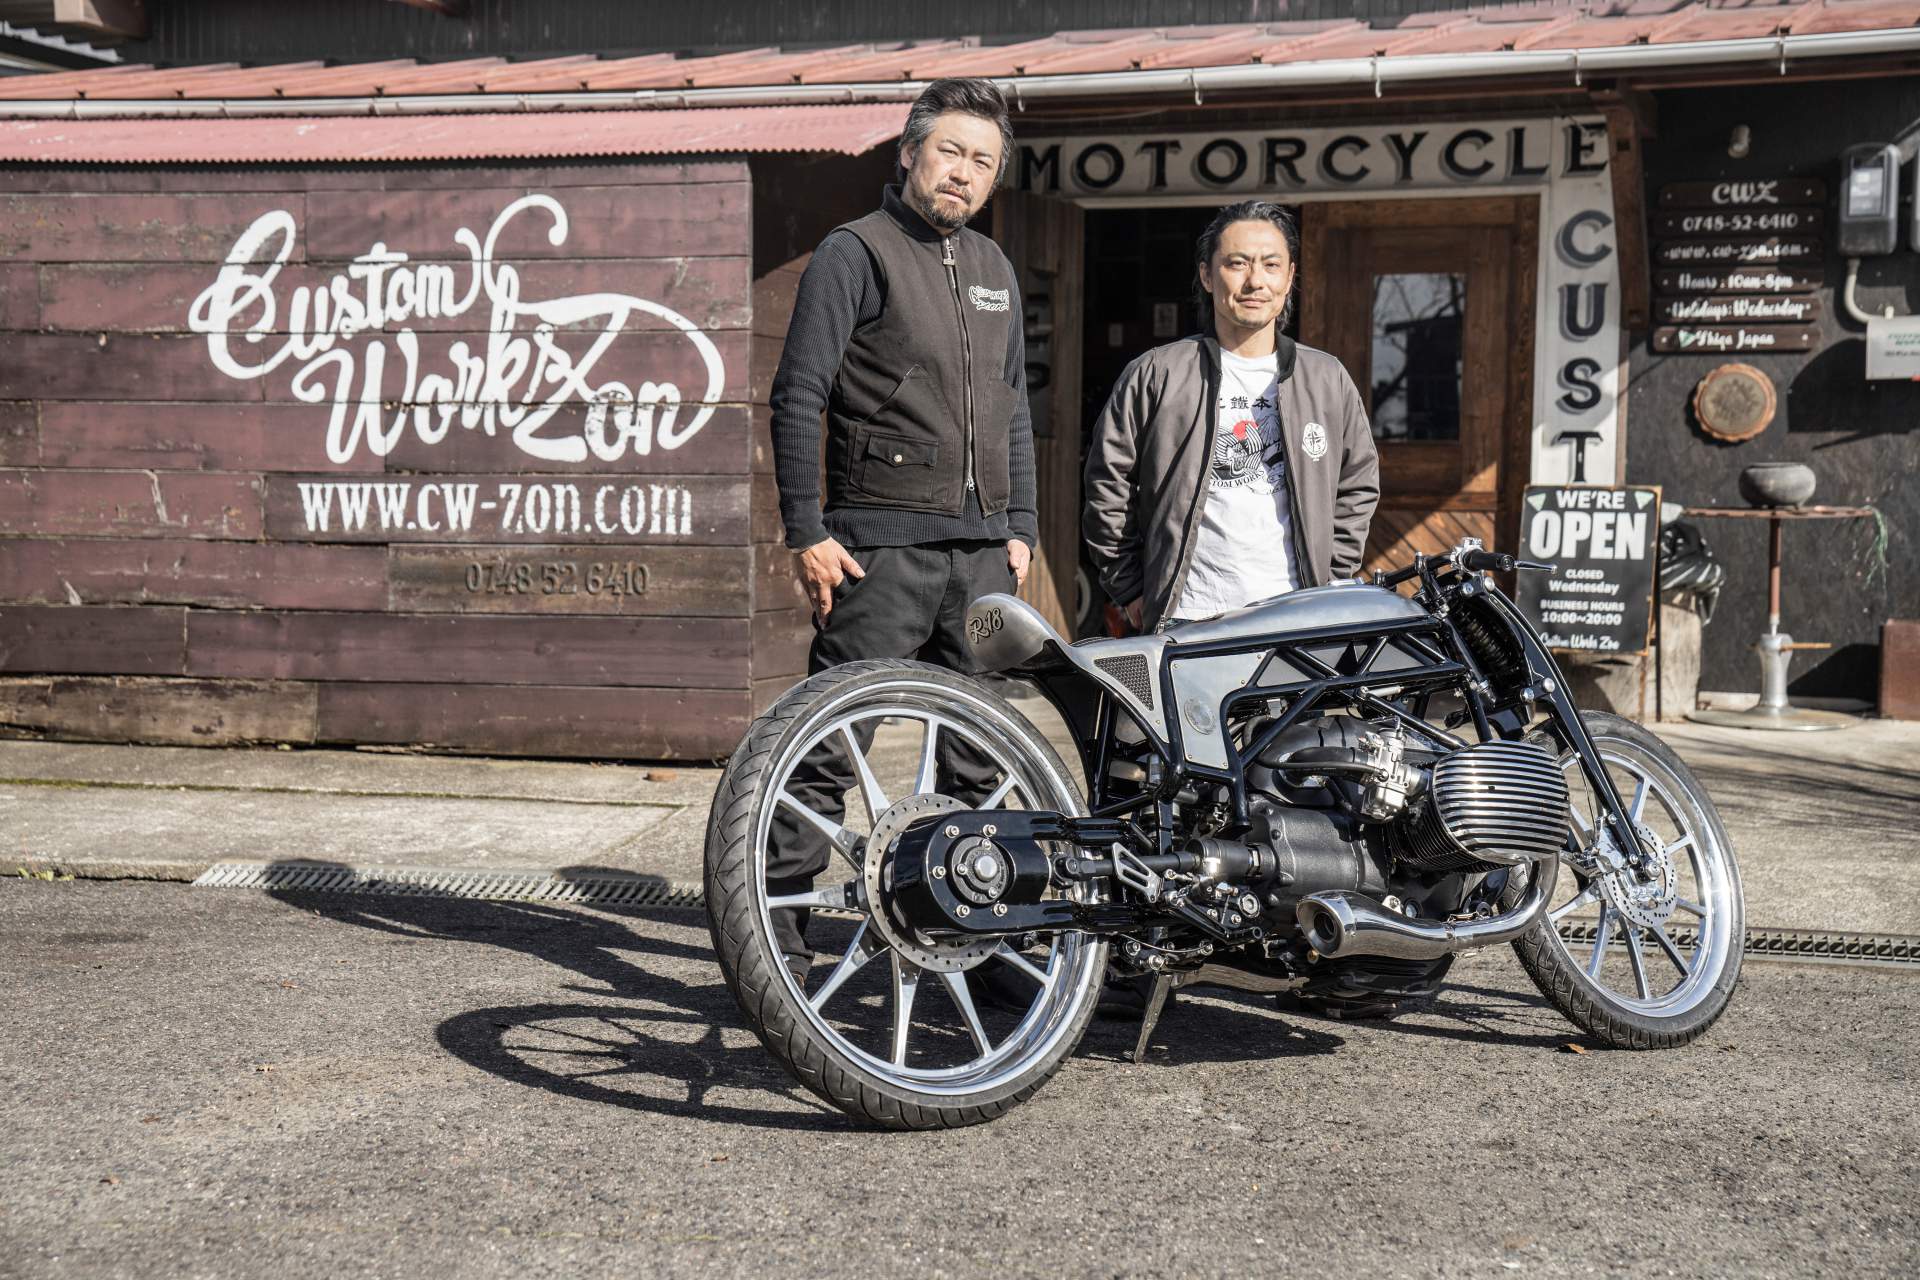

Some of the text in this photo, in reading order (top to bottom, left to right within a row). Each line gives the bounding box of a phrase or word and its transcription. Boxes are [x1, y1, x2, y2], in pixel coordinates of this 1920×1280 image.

[1017, 122, 1609, 192] MOTORCYCLE
[1682, 212, 1798, 232] 0748-52-6410
[189, 209, 482, 379] Custom
[291, 194, 725, 463] Works Zon
[1736, 329, 1775, 349] Japan
[1234, 469, 1265, 488] WORKS
[297, 482, 693, 536] www.cw-zon.com
[1555, 489, 1626, 510] WE'RE
[1529, 509, 1648, 560] OPEN
[465, 562, 651, 597] 0748 52 6410
[1565, 568, 1604, 580] CLOSED
[1549, 580, 1619, 596] Wednesday
[1540, 599, 1625, 612] BUSINESS HOURS
